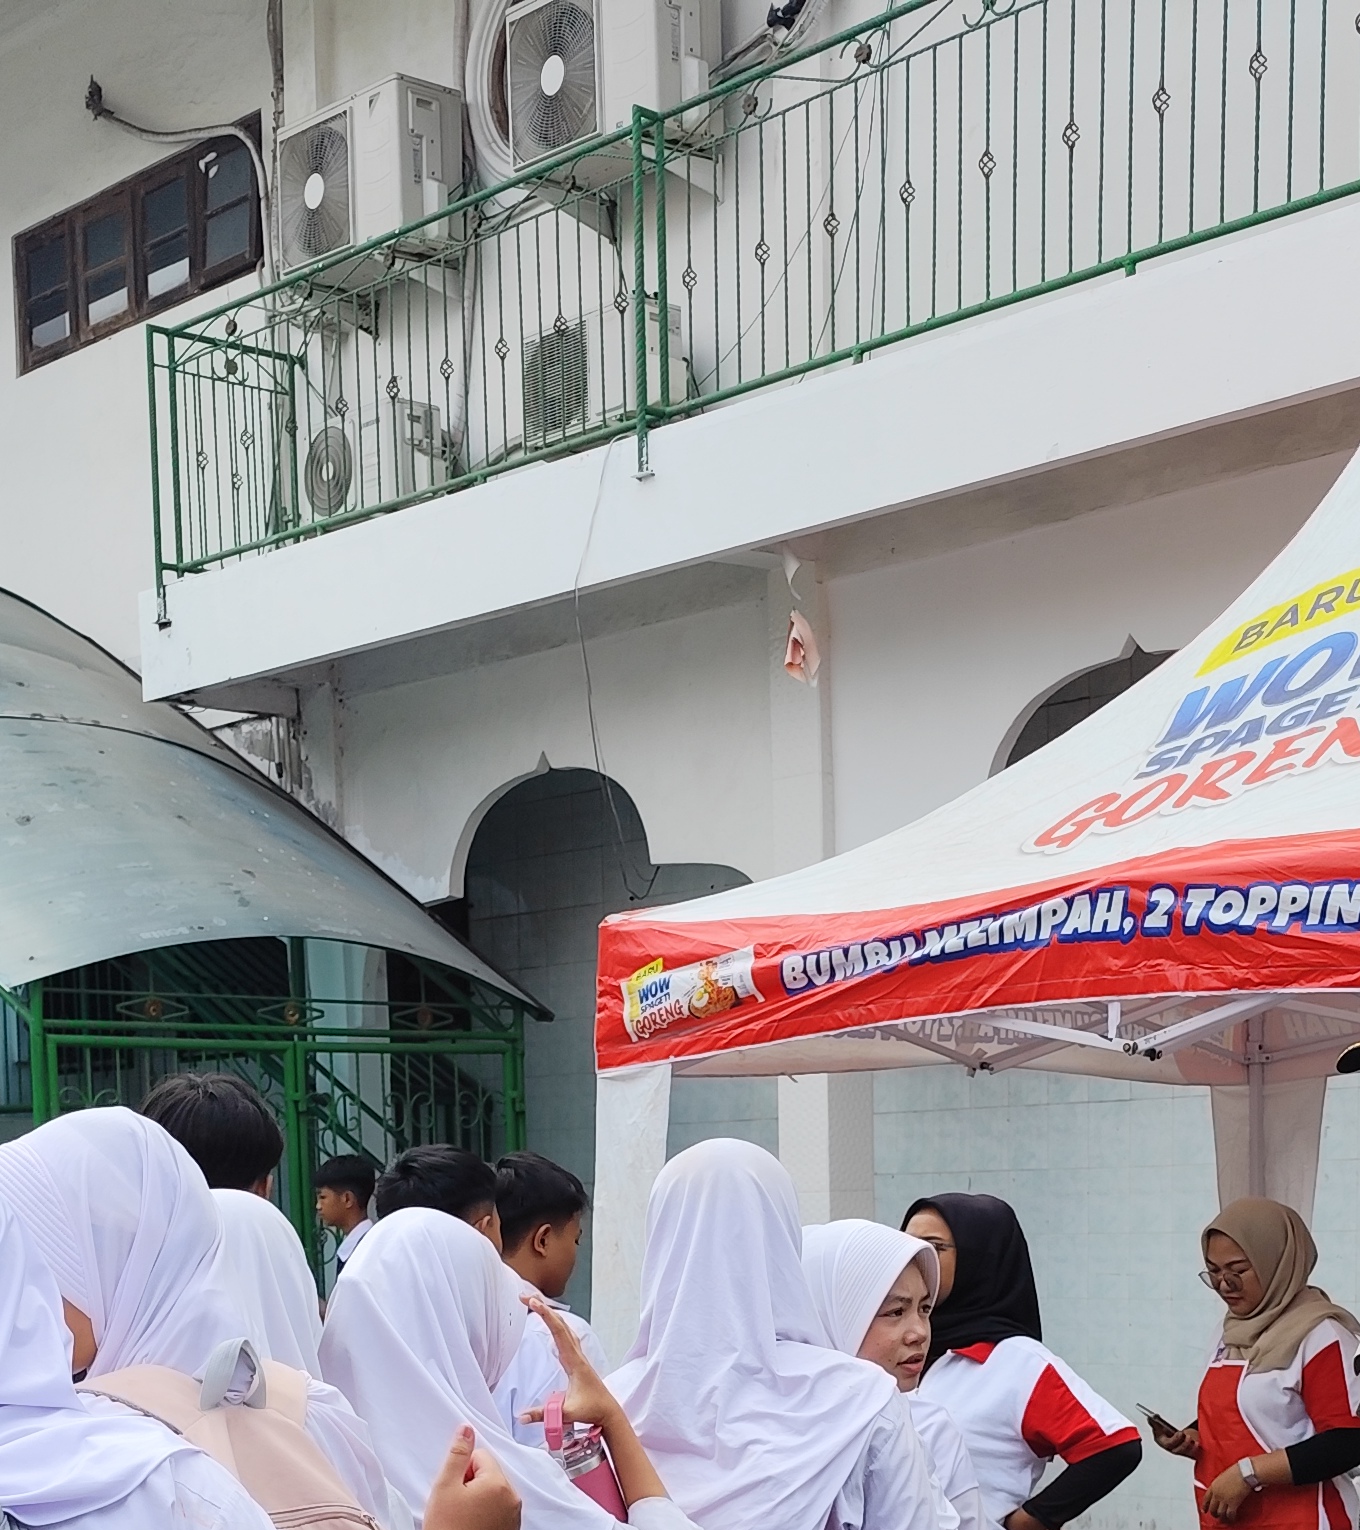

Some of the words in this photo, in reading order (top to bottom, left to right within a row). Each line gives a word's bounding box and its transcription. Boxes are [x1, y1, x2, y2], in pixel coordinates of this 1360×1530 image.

[1145, 887, 1175, 928] 2
[638, 974, 672, 1004] WOW
[636, 999, 685, 1035] GORENG
